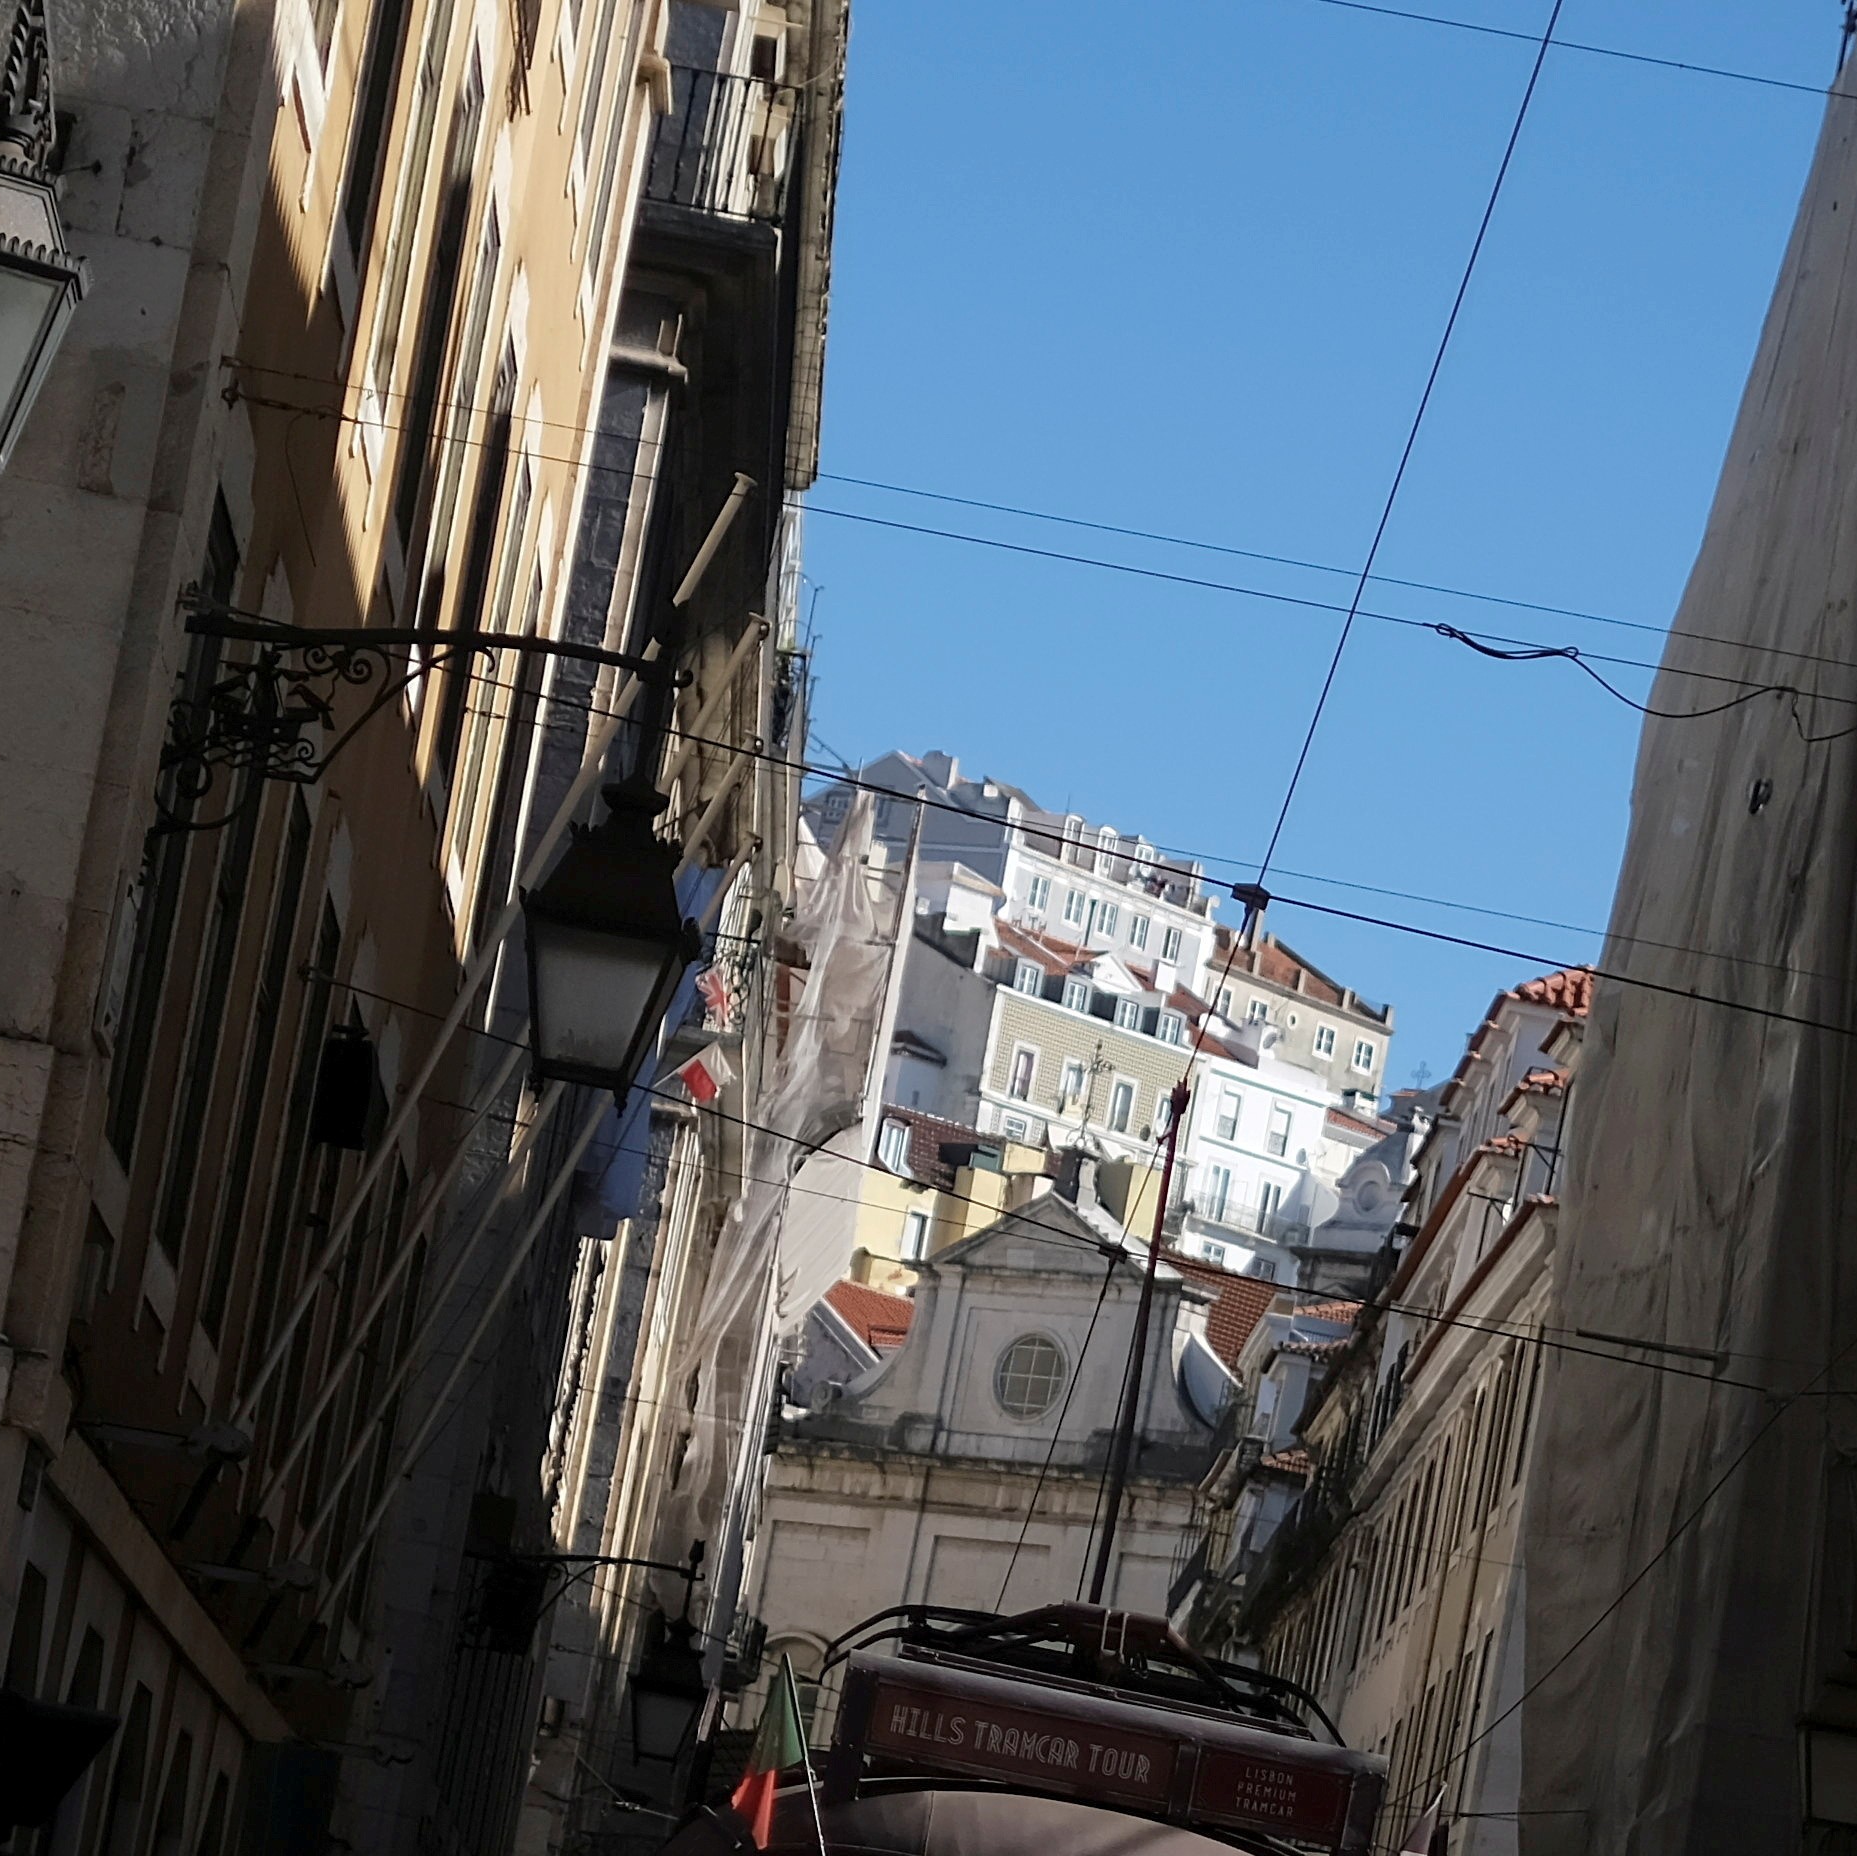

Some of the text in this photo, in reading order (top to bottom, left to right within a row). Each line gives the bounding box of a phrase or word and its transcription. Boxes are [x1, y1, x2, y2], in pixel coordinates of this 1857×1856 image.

[889, 1703, 1151, 1785] HILLS TRAMCAR TOUR
[1244, 1766, 1294, 1787] LISBON
[1236, 1780, 1297, 1804] PREMIUM
[1235, 1796, 1294, 1817] TRAMCAR
